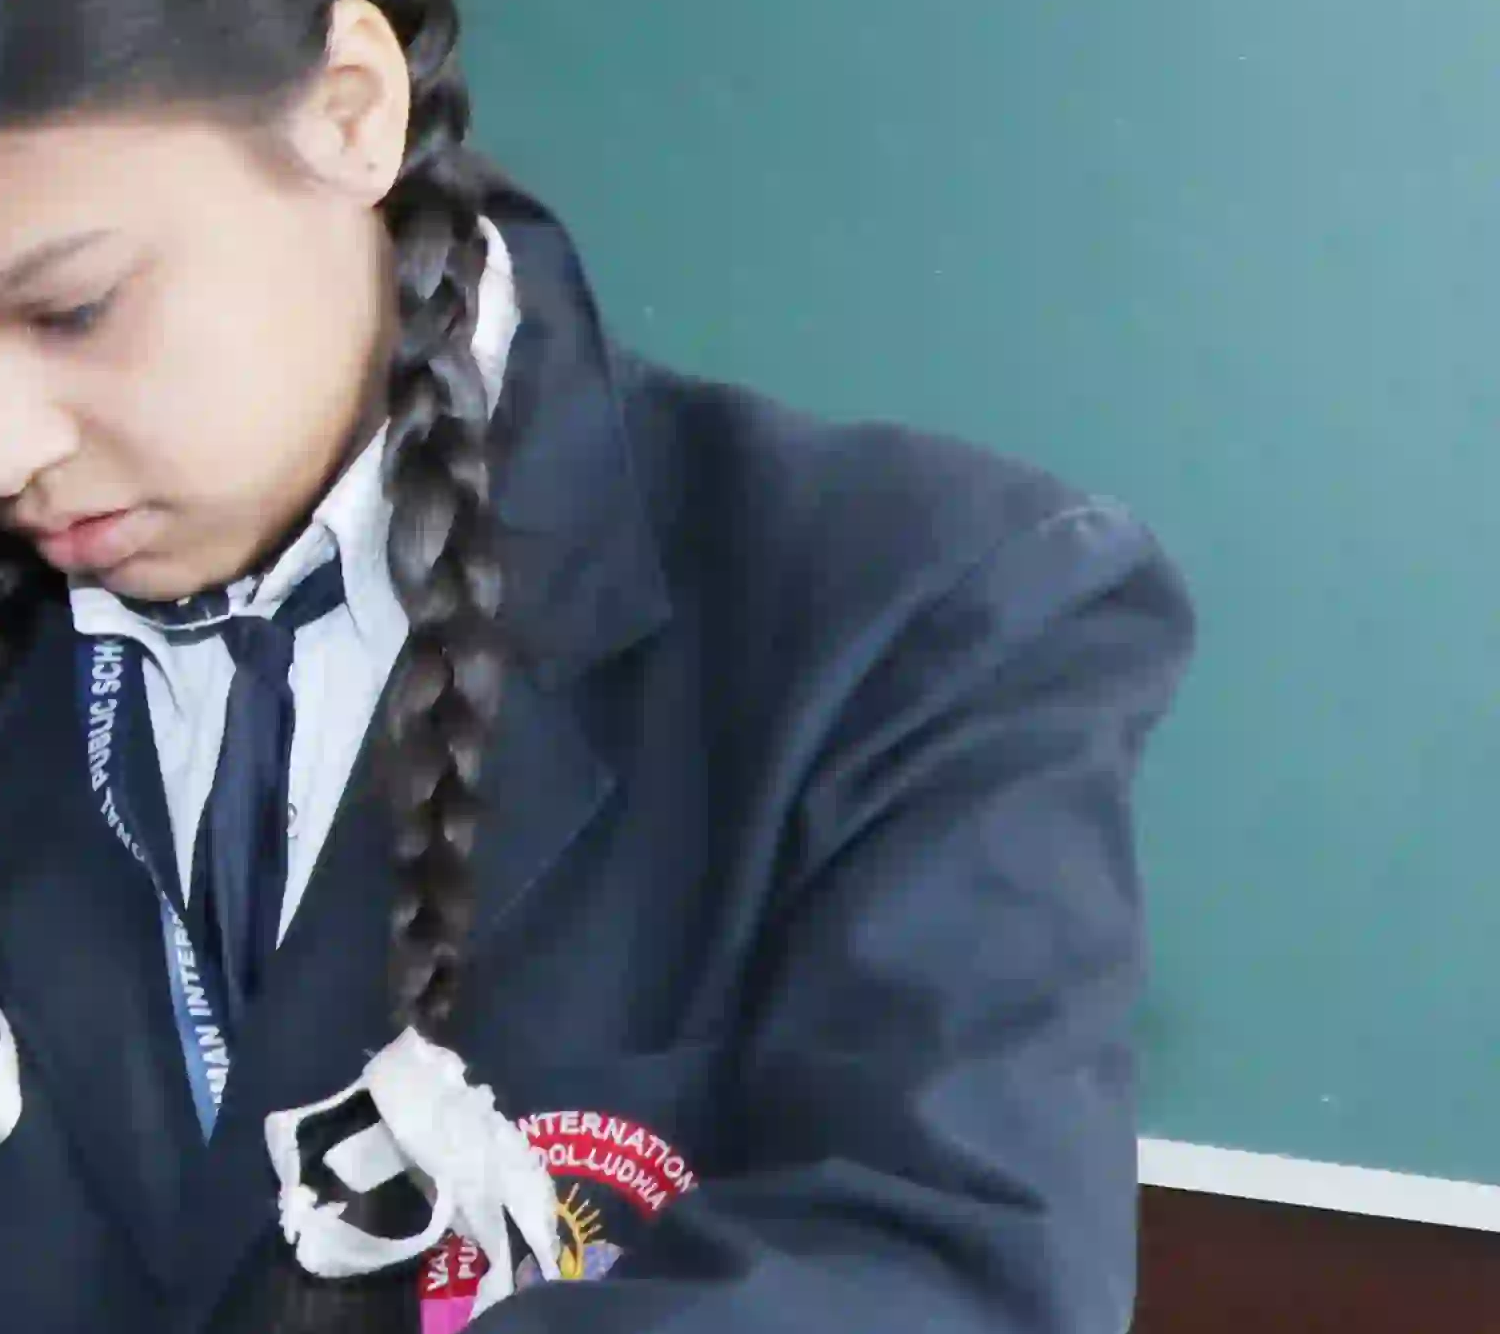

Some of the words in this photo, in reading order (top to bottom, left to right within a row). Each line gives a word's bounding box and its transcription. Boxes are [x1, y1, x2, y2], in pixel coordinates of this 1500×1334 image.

[90, 642, 125, 696] SCH
[87, 698, 118, 793] PUBLIC
[587, 1147, 668, 1211] LUDHIA
